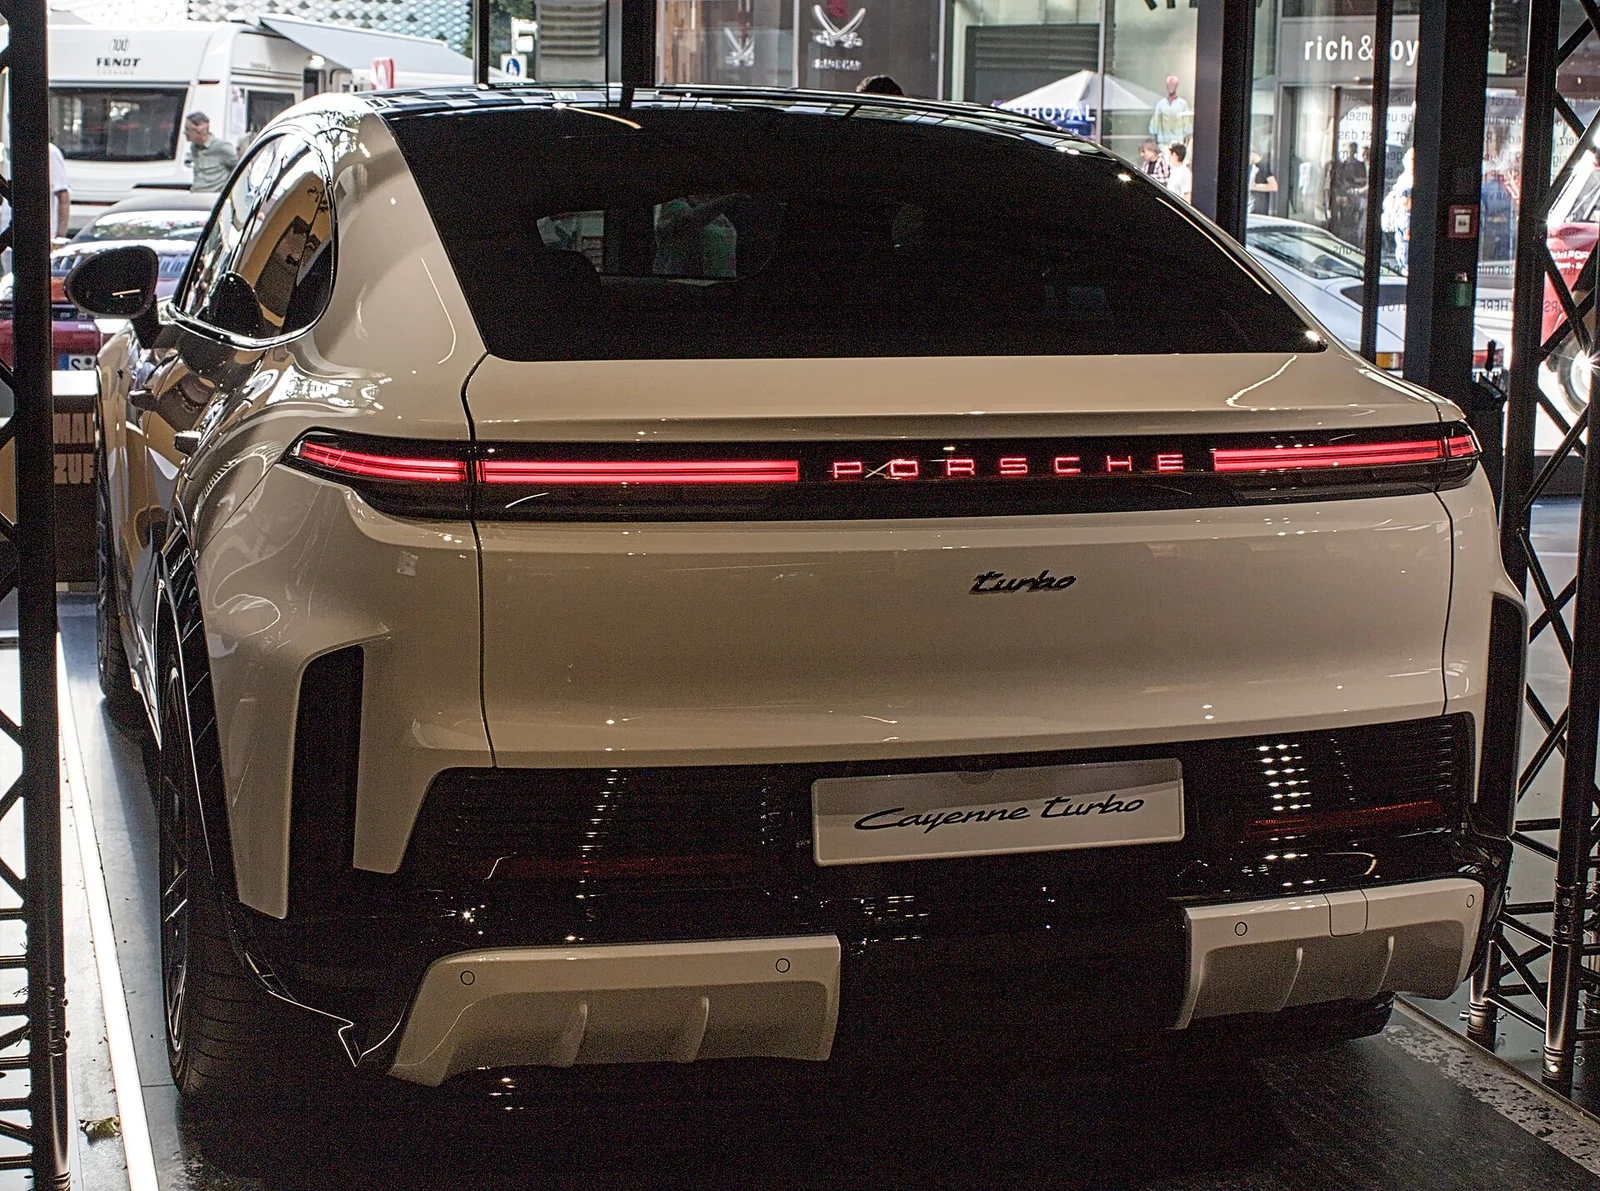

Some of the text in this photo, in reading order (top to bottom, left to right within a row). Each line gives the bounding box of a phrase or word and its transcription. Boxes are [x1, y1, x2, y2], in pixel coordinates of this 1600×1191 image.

[96, 57, 141, 67] FENDT
[1304, 35, 1419, 66] rich&oy
[833, 453, 1184, 479] PORSCHE
[969, 570, 1077, 595] turbo
[853, 793, 1145, 834] Cayenne turbo
